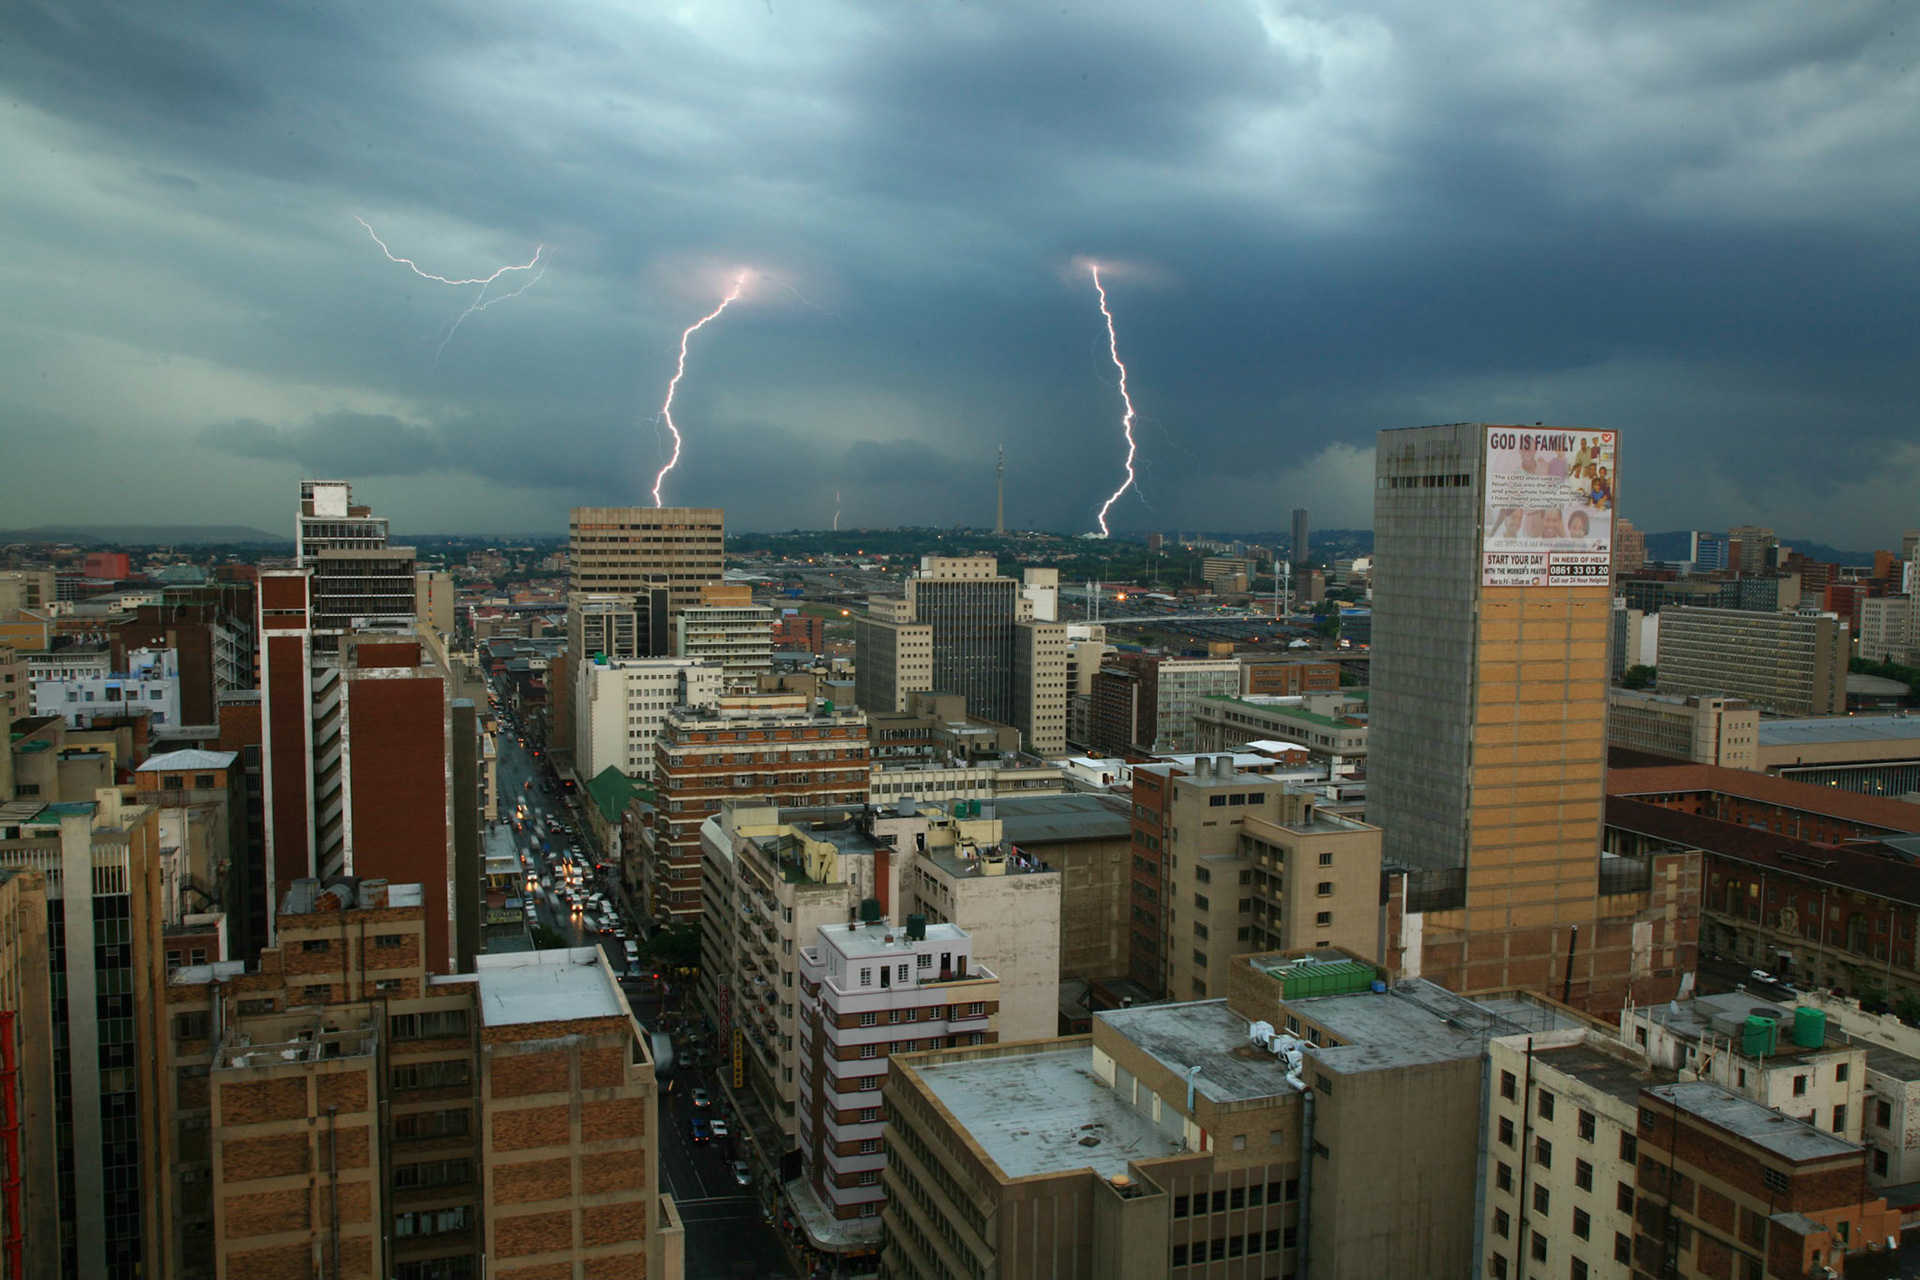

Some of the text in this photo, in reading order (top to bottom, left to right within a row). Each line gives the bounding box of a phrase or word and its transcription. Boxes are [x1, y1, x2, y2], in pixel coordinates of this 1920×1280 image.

[1491, 433, 1575, 451] GOD IS FAMILY
[1488, 554, 1543, 564] START YOUR DAY
[1507, 566, 1529, 574] WORKER'S
[1550, 566, 1609, 574] 0861 33 03 20
